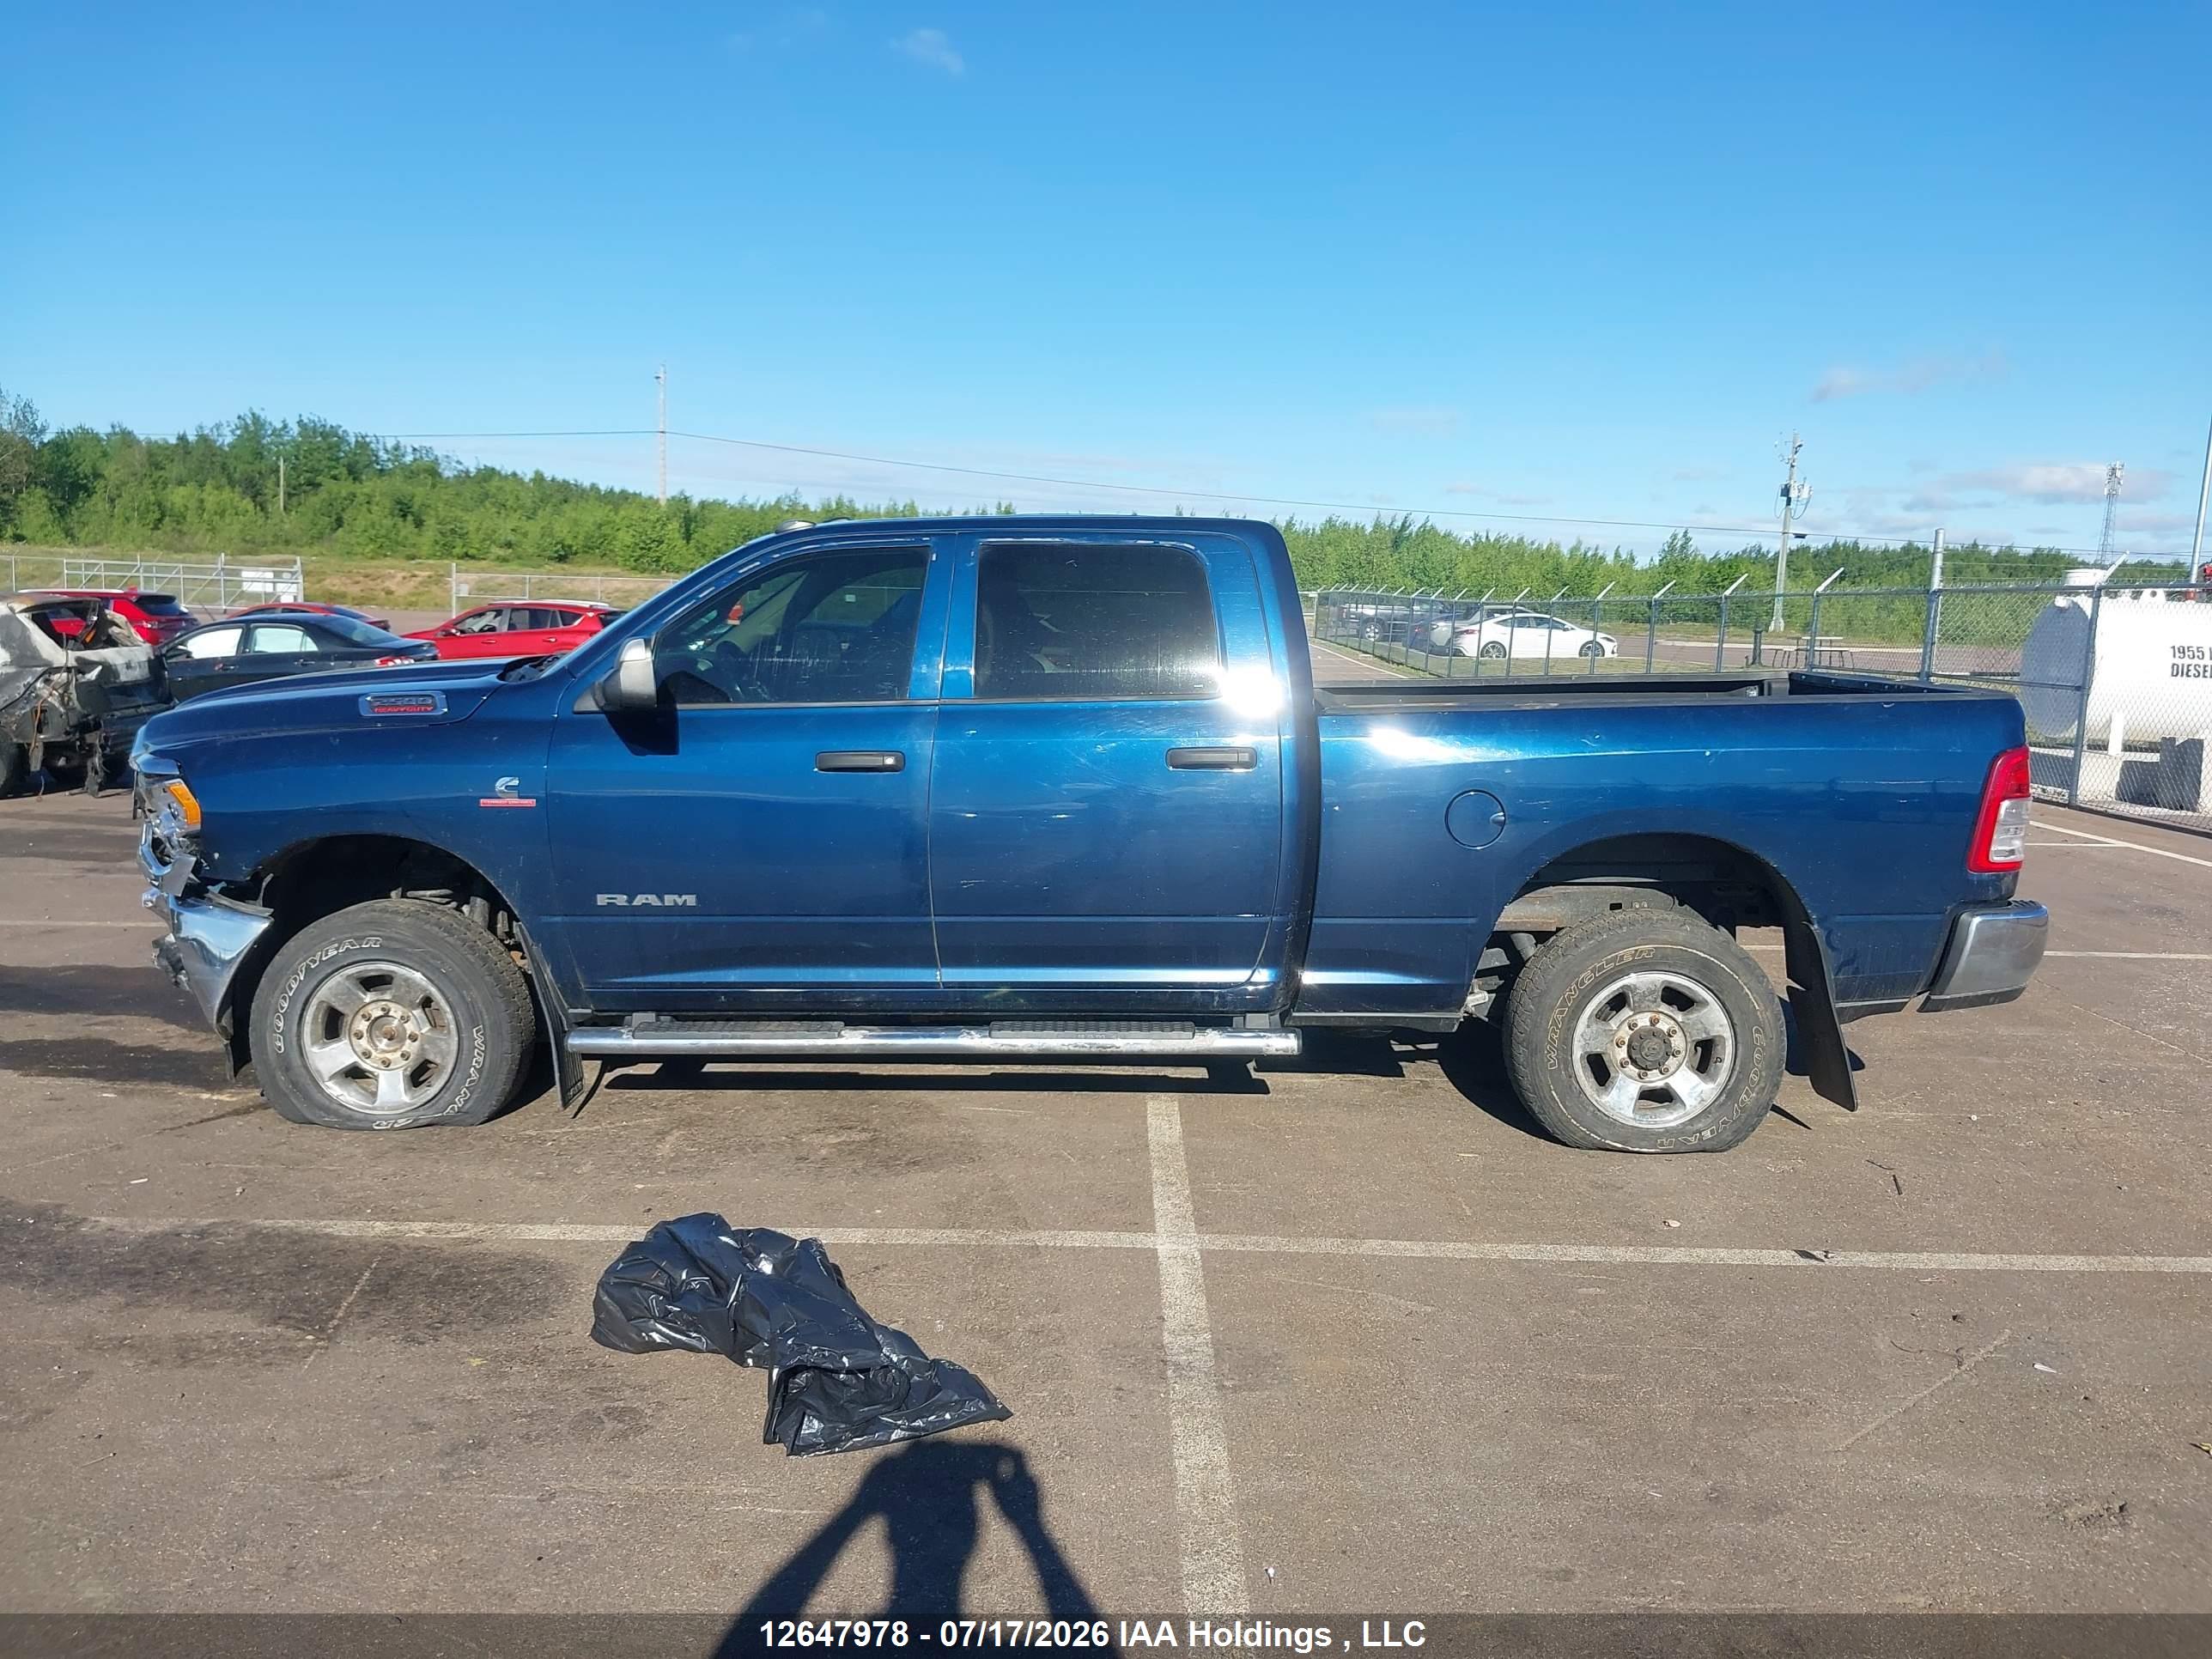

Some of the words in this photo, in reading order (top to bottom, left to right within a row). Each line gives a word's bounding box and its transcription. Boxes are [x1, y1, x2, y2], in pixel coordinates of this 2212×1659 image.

[2170, 645, 2205, 660] 1955
[596, 893, 697, 907] RAM
[273, 936, 383, 1054] GOODYEAR
[1547, 947, 1656, 1070] WRANGLER
[1656, 1025, 1766, 1150] GOODYEAR
